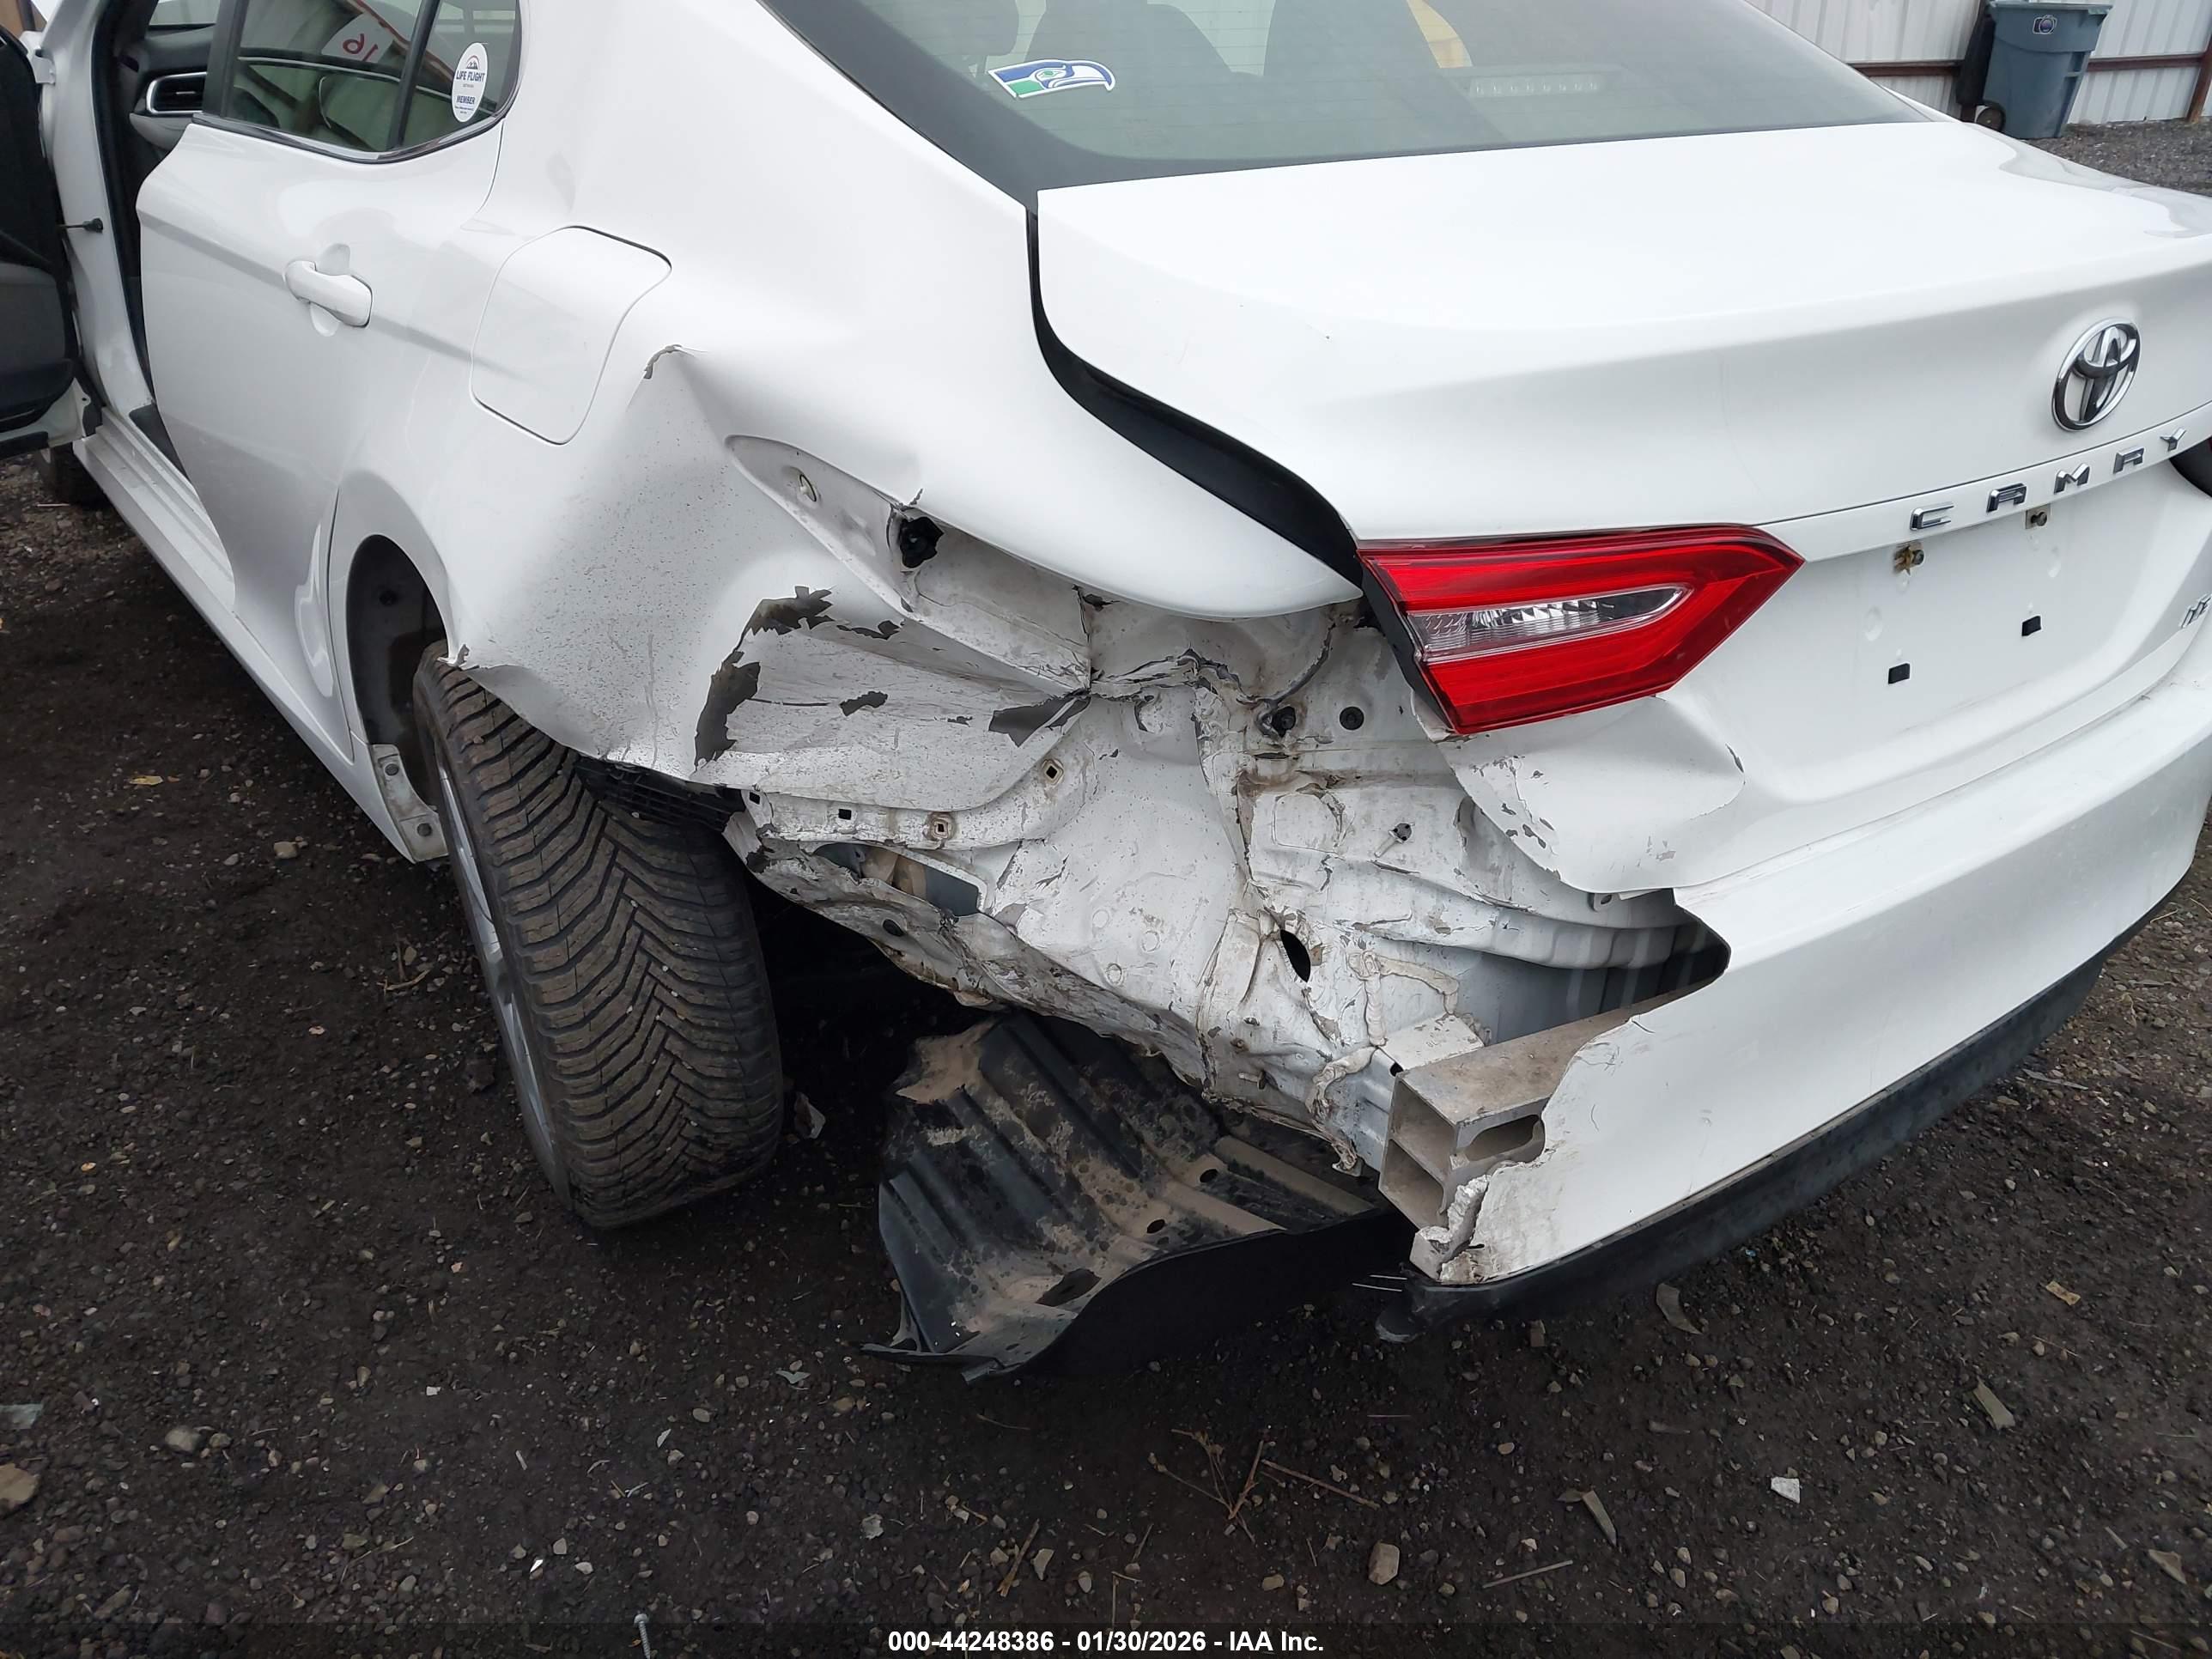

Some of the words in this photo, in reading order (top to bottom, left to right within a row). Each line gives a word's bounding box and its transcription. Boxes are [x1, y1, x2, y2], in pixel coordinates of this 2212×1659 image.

[456, 70, 467, 80] LIFE
[467, 71, 485, 82] FLIGHT
[456, 95, 476, 105] MEMBER
[1910, 428, 2187, 532] CAMRY
